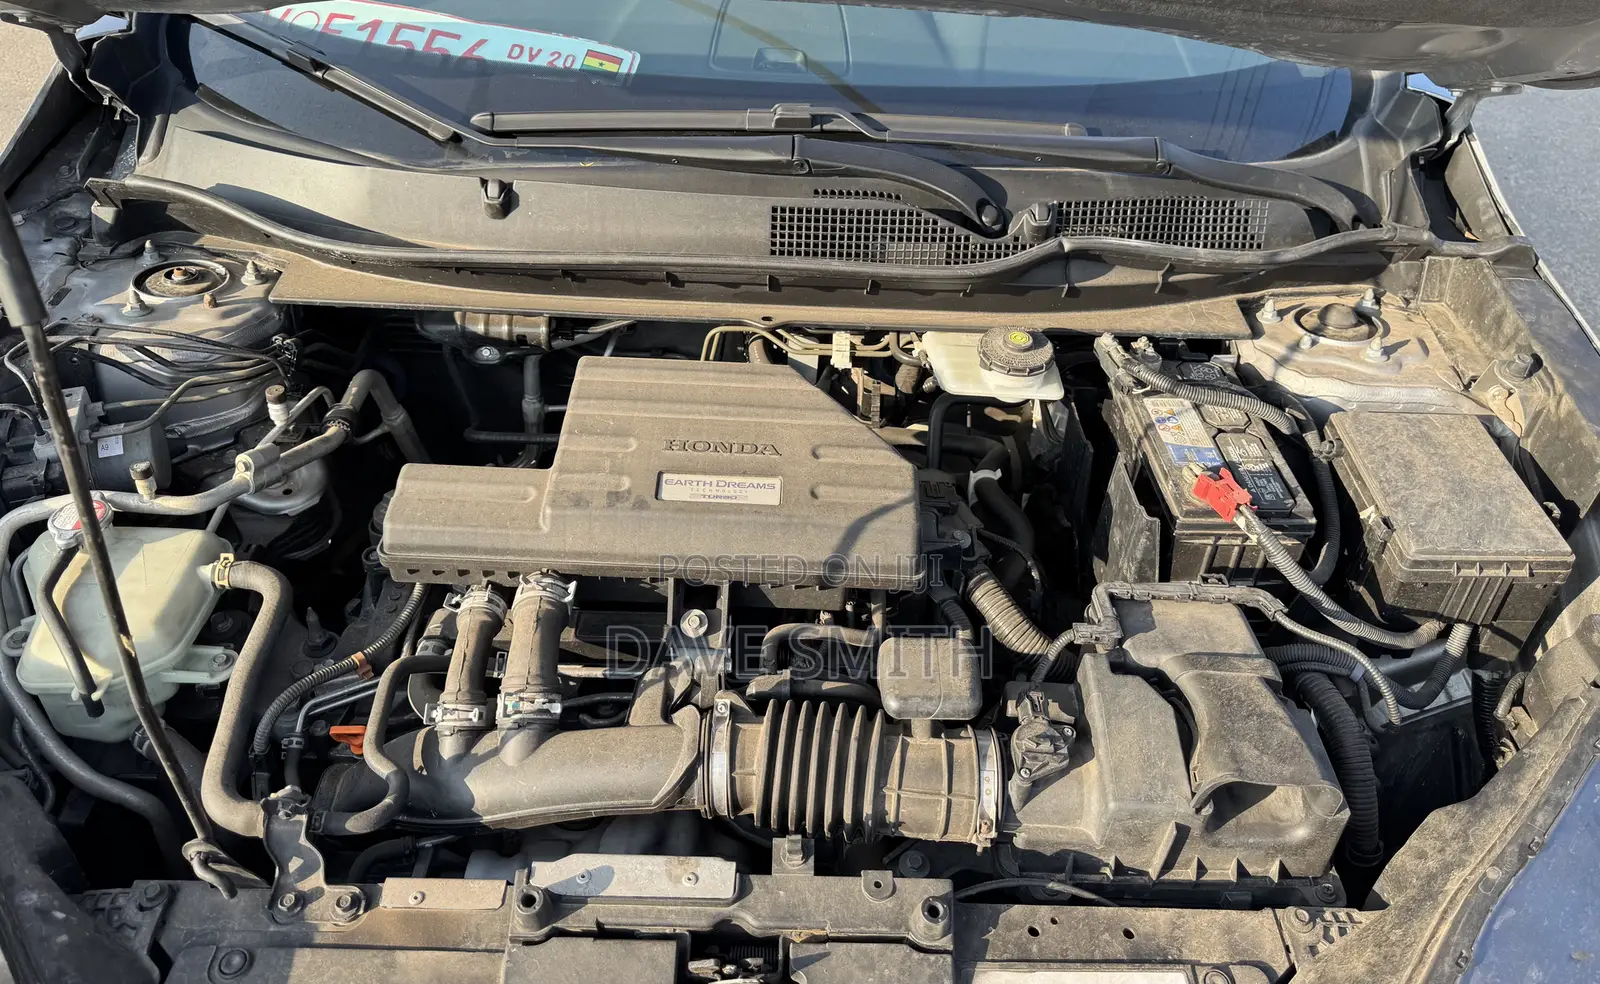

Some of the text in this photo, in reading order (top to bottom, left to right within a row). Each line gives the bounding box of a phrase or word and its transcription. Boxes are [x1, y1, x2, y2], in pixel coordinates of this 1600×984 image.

[507, 44, 543, 62] DV
[546, 50, 576, 70] 20
[662, 439, 782, 456] HONDA
[664, 479, 776, 489] EARTH DREAMS
